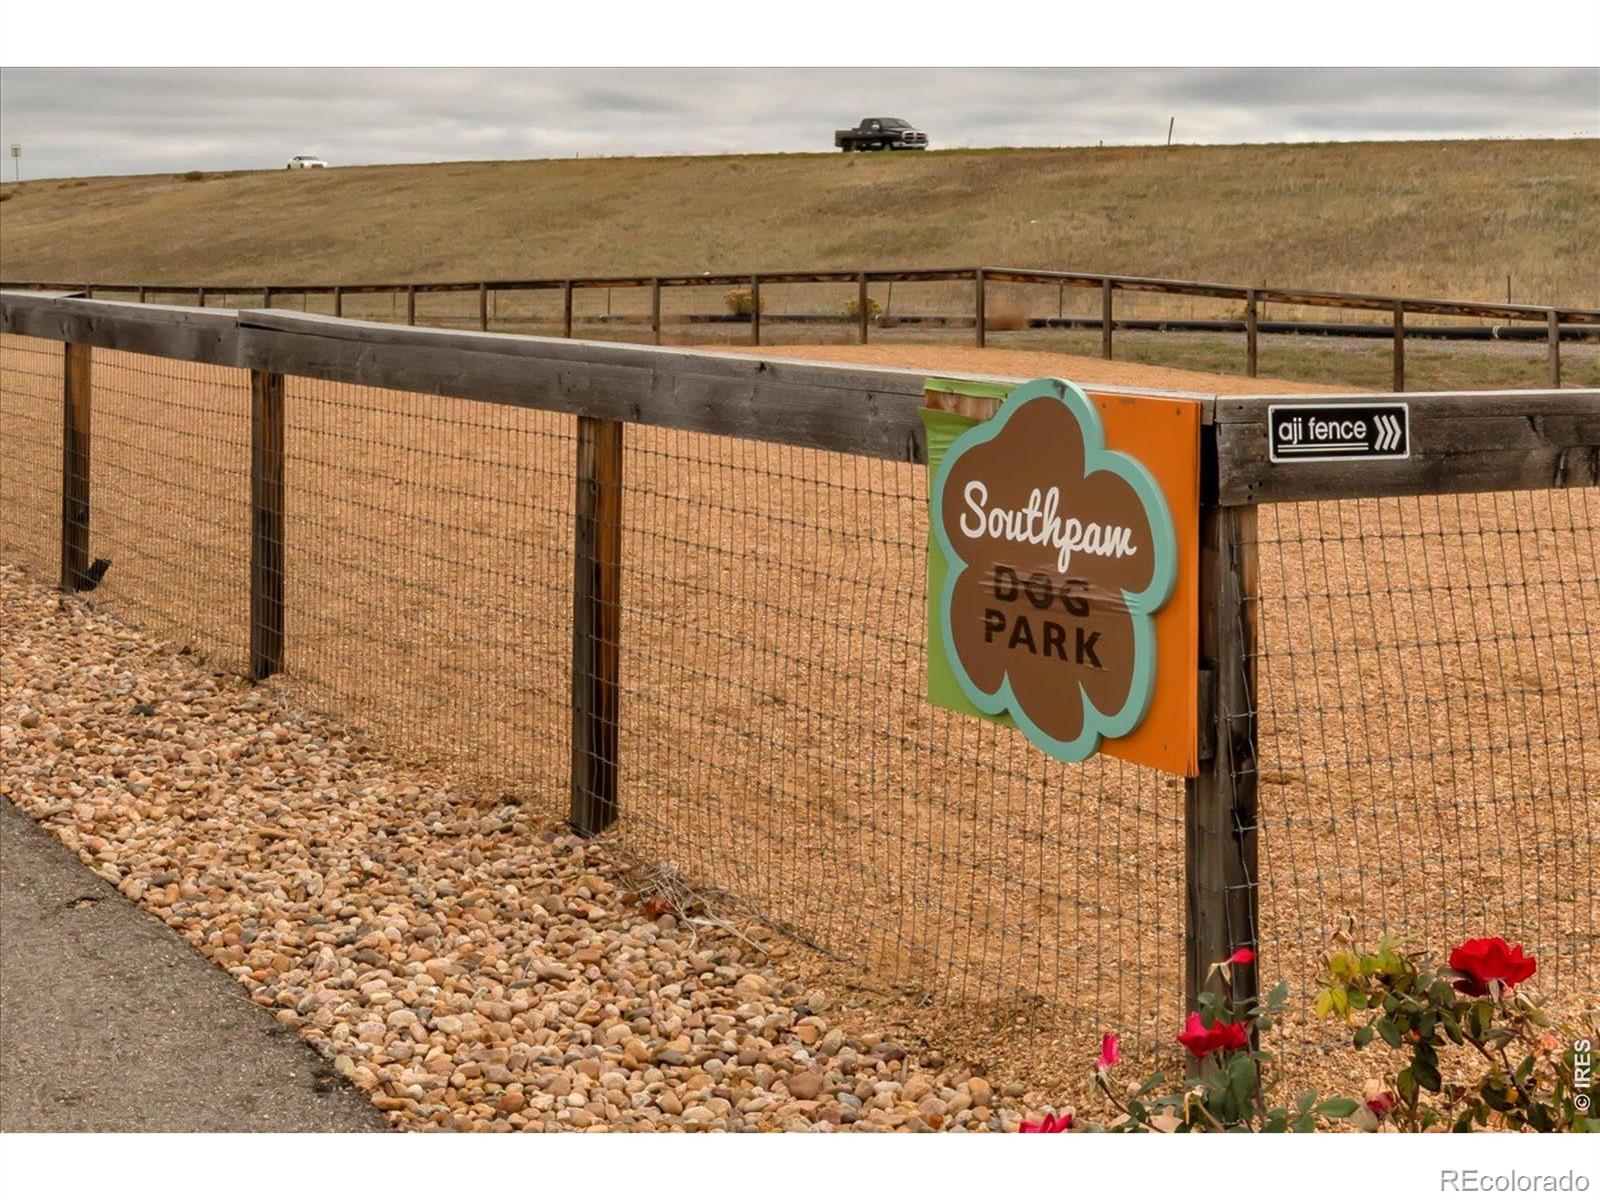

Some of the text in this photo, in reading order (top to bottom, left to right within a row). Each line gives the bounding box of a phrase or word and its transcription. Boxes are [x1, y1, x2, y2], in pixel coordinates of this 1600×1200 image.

[1278, 416, 1367, 445] aji fence
[960, 480, 1138, 574] Southpaw
[993, 564, 1091, 619] DOG
[983, 607, 1104, 669] PARK
